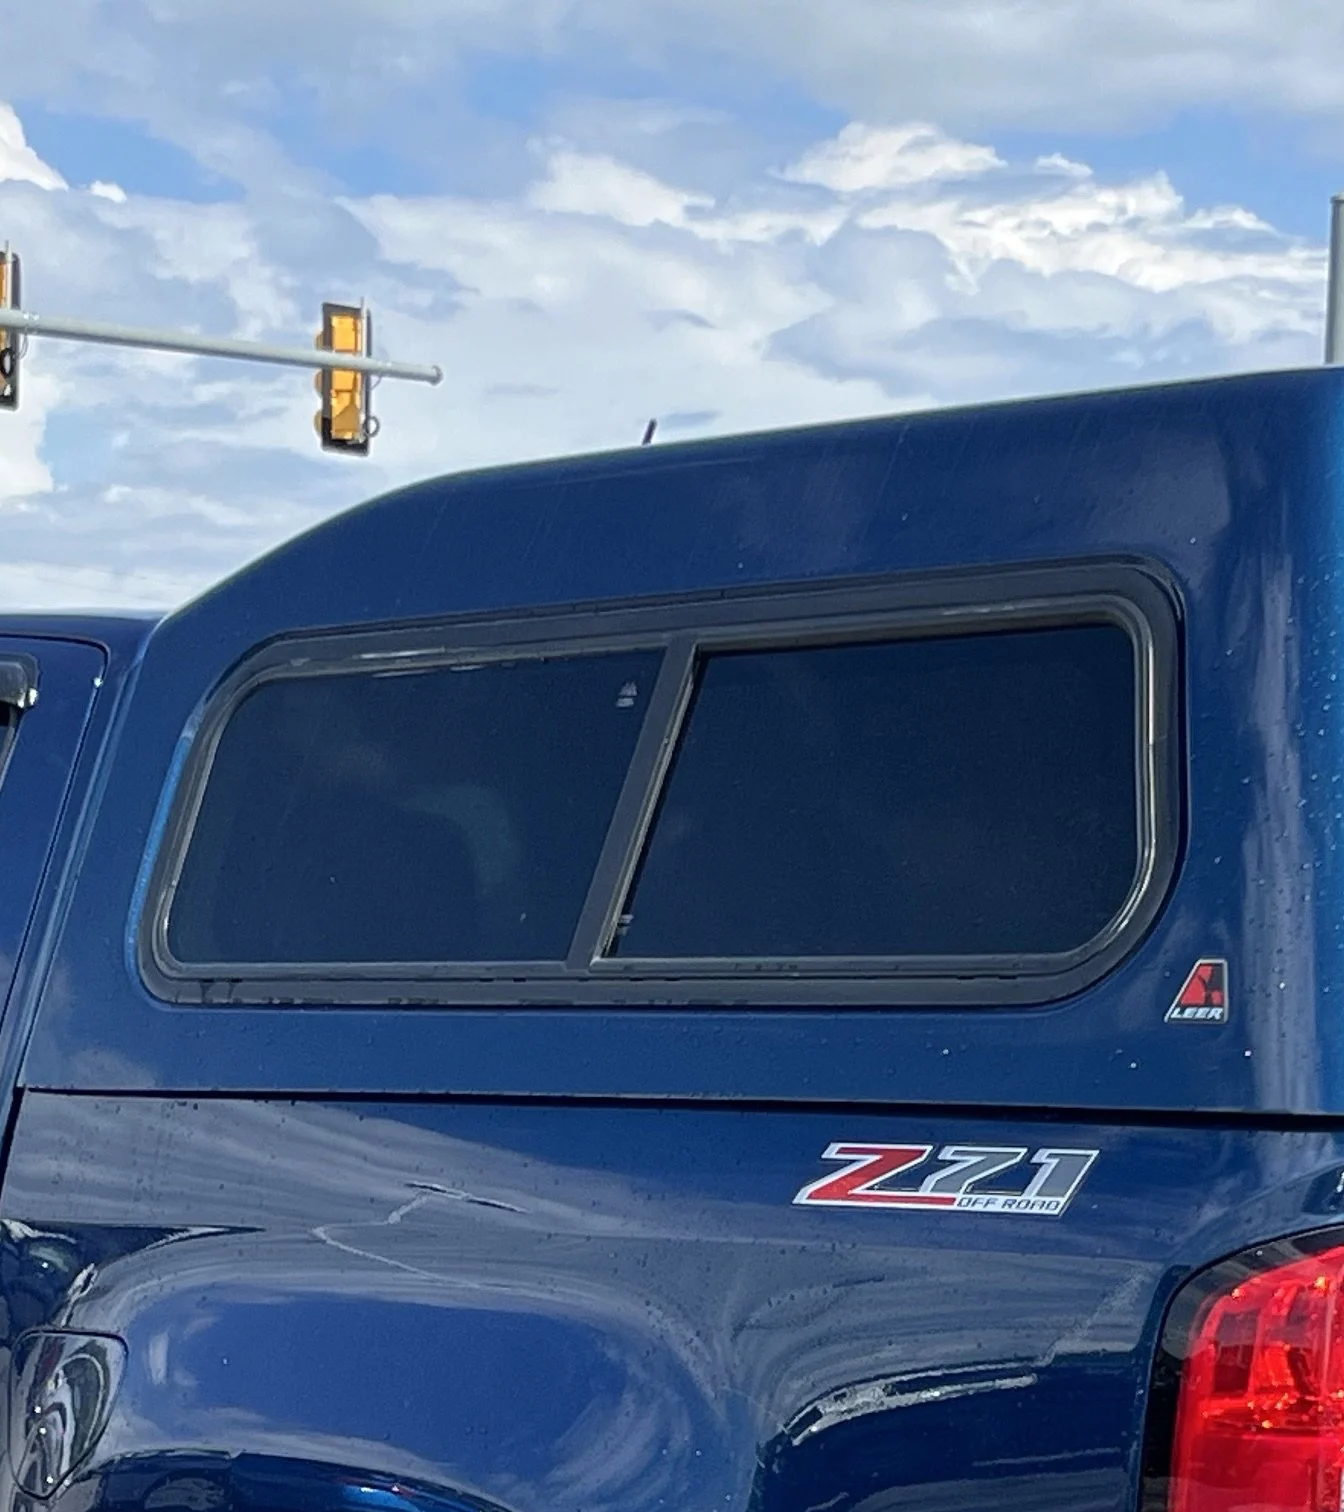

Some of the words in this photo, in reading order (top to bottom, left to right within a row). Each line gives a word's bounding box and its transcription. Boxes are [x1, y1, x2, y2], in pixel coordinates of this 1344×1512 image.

[1170, 1006, 1224, 1020] LEER
[792, 1142, 1100, 1208] Z71
[957, 1197, 998, 1208] OFF
[1001, 1198, 1060, 1211] ROAD
